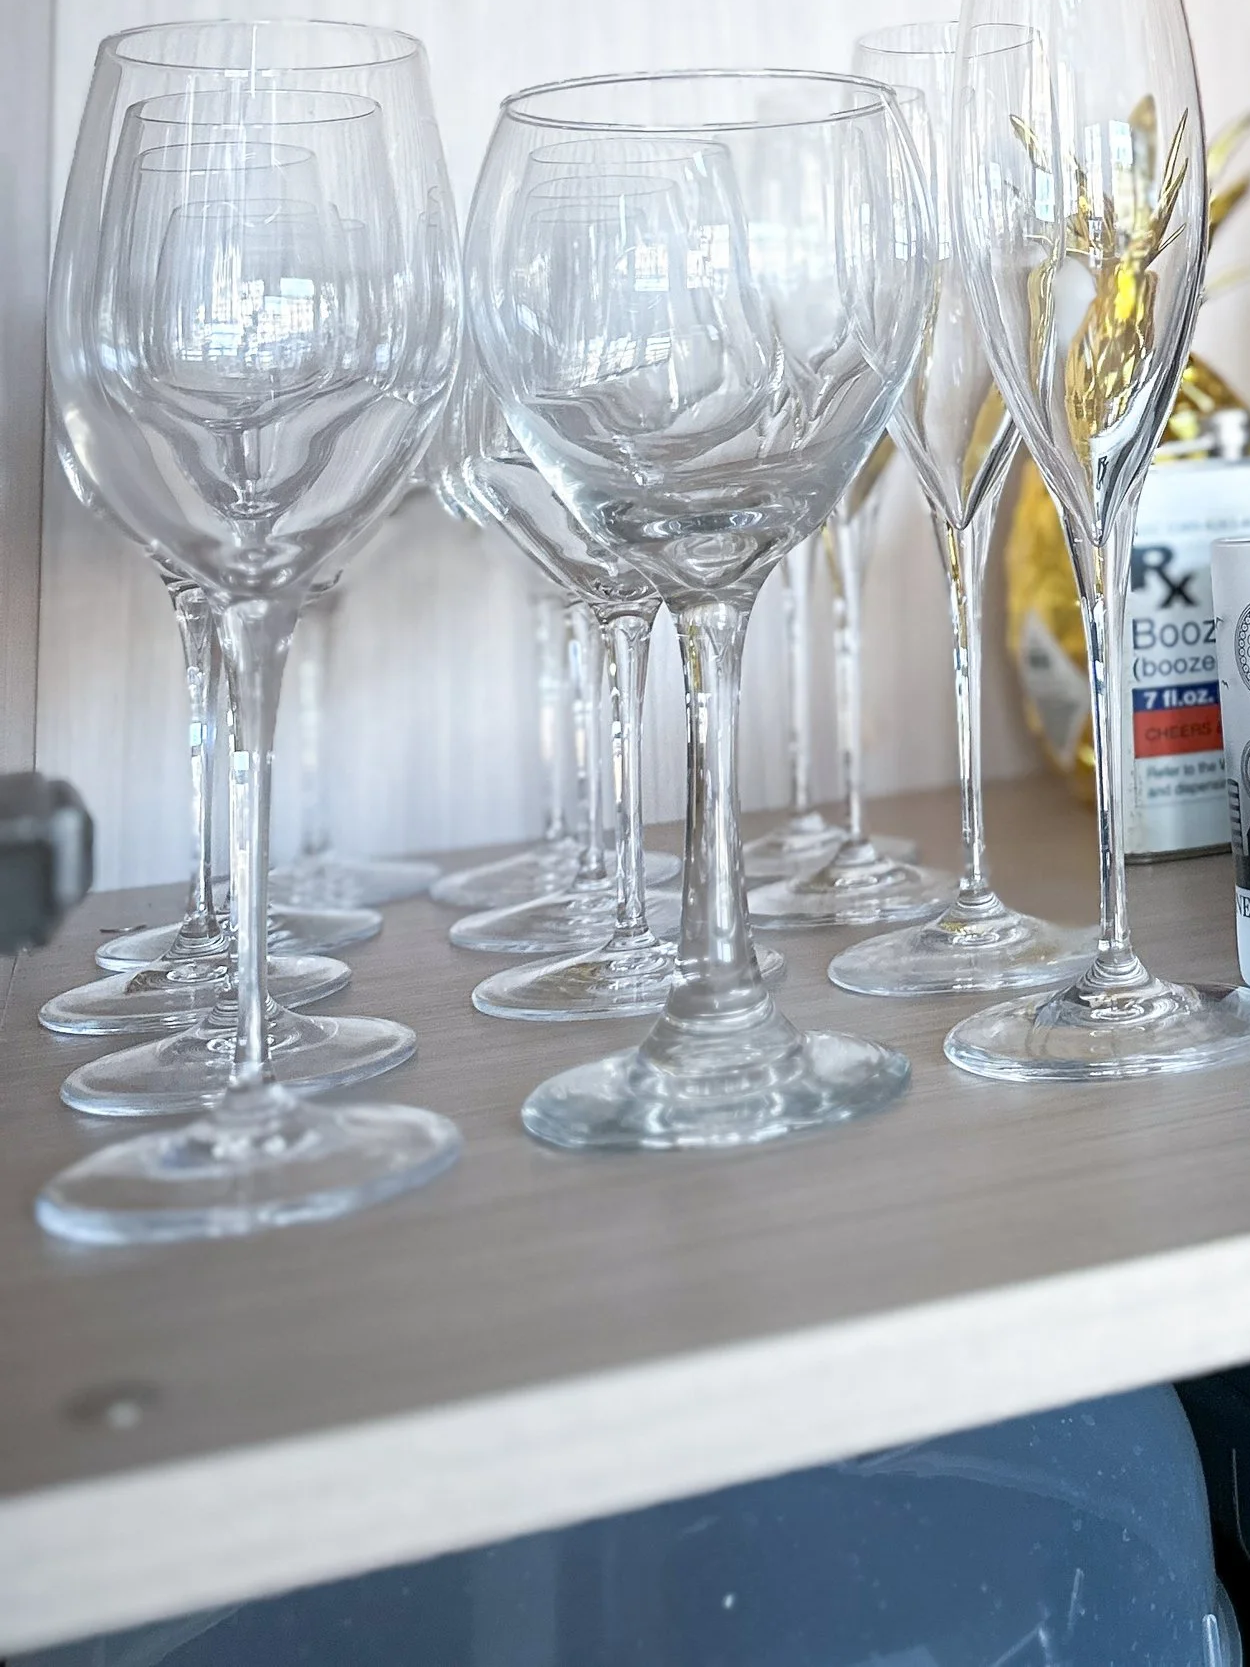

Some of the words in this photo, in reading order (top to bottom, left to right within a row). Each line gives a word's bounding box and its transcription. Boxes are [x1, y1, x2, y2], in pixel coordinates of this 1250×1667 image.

[1131, 545, 1199, 609] Rx
[1132, 618, 1217, 651] Booz
[1143, 691, 1158, 710] 7
[1145, 721, 1213, 741] CHEERS
